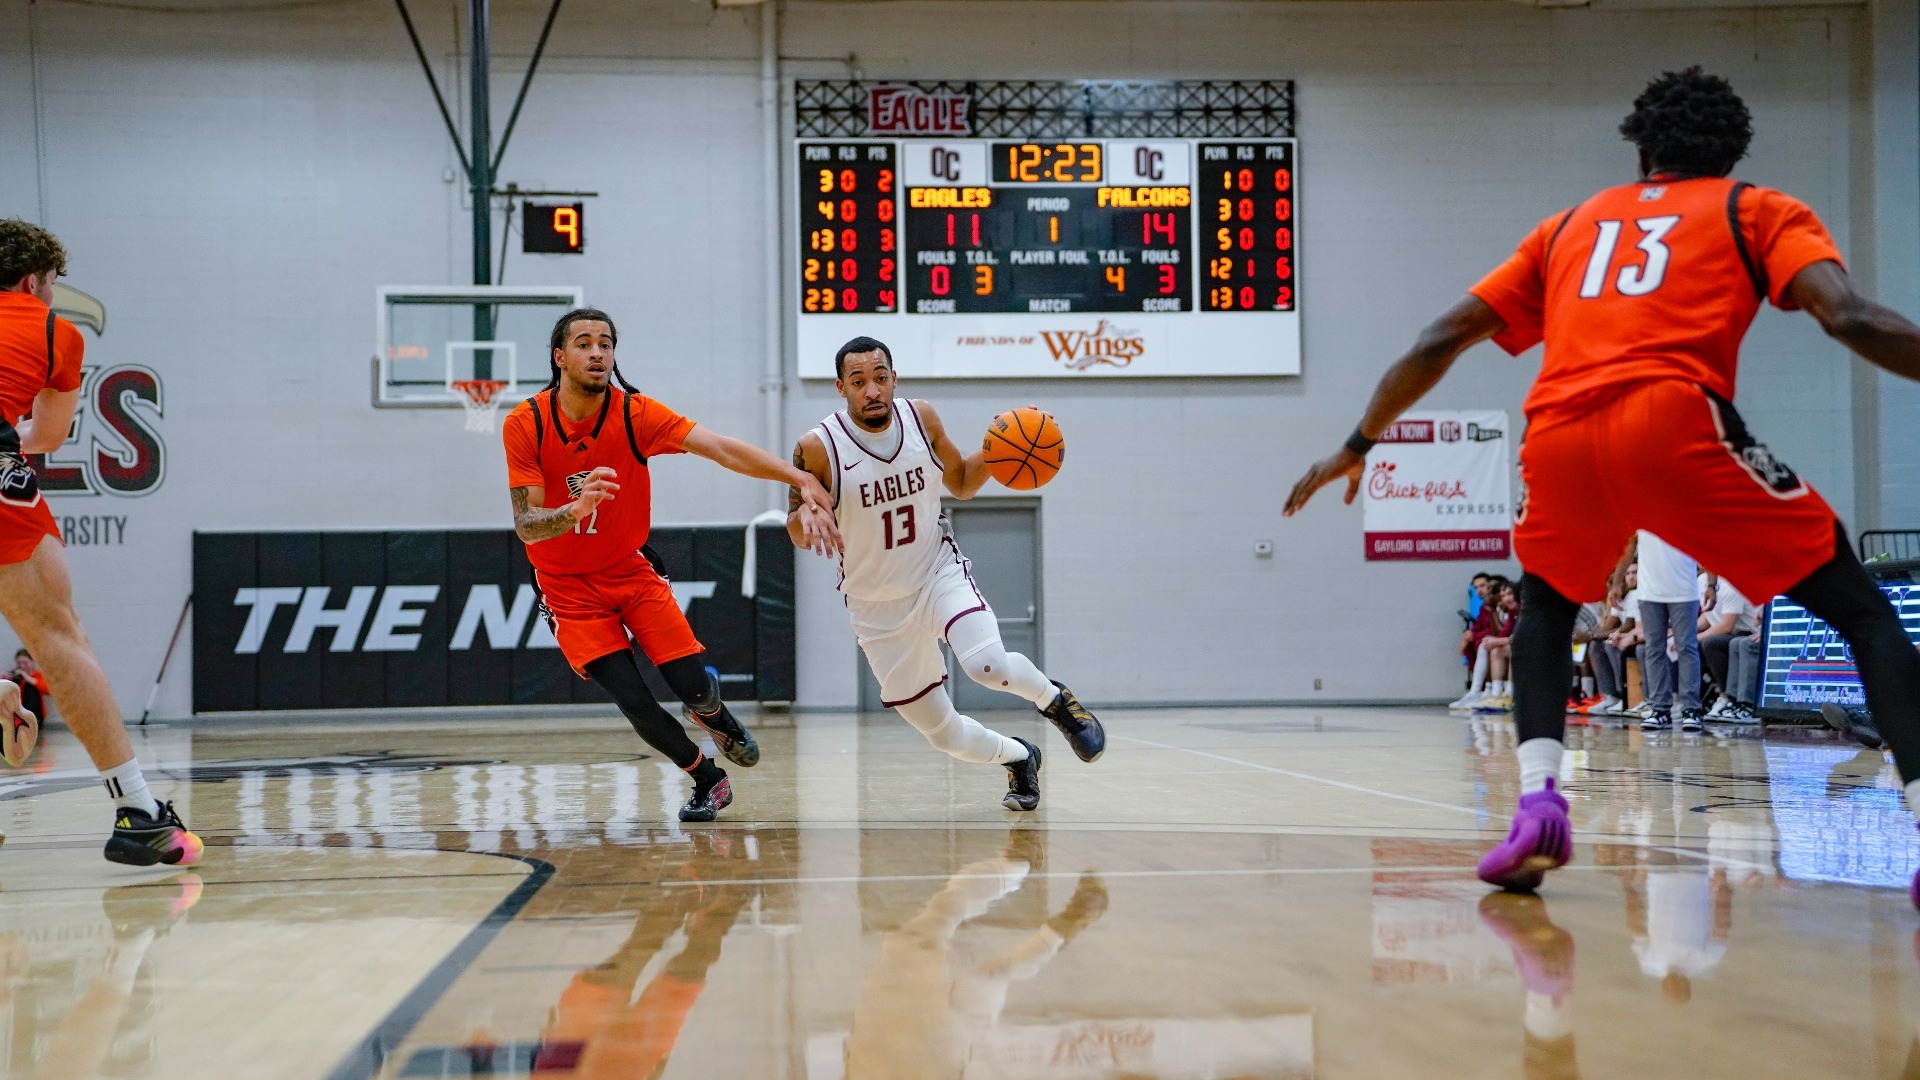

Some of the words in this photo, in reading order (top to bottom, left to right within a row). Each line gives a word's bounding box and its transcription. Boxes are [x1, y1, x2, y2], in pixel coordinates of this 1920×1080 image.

[870, 88, 970, 131] EAGLE
[805, 146, 830, 160] PLYR
[839, 146, 857, 160] FLS
[868, 146, 887, 160] PTS
[1010, 144, 1100, 182] 12:23
[1204, 146, 1229, 160] PLYR
[1237, 146, 1255, 160] FLS
[1265, 146, 1284, 160] PTS
[819, 169, 834, 193] 3
[840, 169, 856, 193] 0
[877, 169, 893, 193] 2
[1223, 170, 1232, 191] 1
[1238, 168, 1254, 192] 0
[1274, 168, 1290, 192] 0
[910, 187, 992, 208] EAGLES
[1027, 197, 1070, 212] PERIOD
[1097, 187, 1191, 208] FALCONS
[818, 201, 834, 221] 4
[840, 199, 857, 223] 0
[877, 199, 894, 223] 0
[1218, 198, 1232, 222] 3
[1238, 198, 1254, 222] 0
[1275, 198, 1291, 222] 0
[554, 207, 578, 247] 9
[946, 213, 981, 246] 11
[1050, 216, 1059, 243] 1
[1142, 212, 1176, 245] 14
[811, 229, 835, 252] 13
[841, 229, 857, 252] 0
[880, 229, 895, 252] 3
[1216, 228, 1233, 251] 5
[1239, 228, 1255, 251] 0
[1275, 228, 1291, 251] 0
[917, 250, 956, 265] FOULS
[965, 250, 999, 265] T.O.L.
[1010, 250, 1056, 265] PLAYER
[1058, 250, 1090, 265] FOUL
[1098, 250, 1131, 264] T.O.L.
[1141, 249, 1180, 264] FOULS
[1210, 257, 1233, 280] 12
[1246, 258, 1255, 277] 1
[1275, 256, 1291, 280] 6
[1579, 214, 1683, 299] 13
[804, 258, 835, 282] 21
[841, 258, 858, 282] 0
[879, 258, 895, 282] 2
[931, 265, 950, 296] 0
[975, 265, 993, 296] 3
[1105, 266, 1125, 293] 4
[1158, 264, 1176, 294] 3
[804, 288, 835, 311] 23
[841, 288, 858, 311] 0
[879, 289, 895, 310] 4
[917, 299, 956, 313] SCORE
[1029, 298, 1071, 312] MATCH
[1142, 298, 1181, 312] SCORE
[1210, 286, 1234, 309] 13
[1240, 286, 1255, 309] 0
[1276, 286, 1292, 309] 2
[956, 335, 1015, 346] FRIENDS
[1018, 335, 1036, 345] OF
[1040, 324, 1145, 369] Wings
[859, 466, 925, 508] EAGLES
[1436, 503, 1506, 515] EXPRESS
[56, 515, 128, 546] RSITY
[881, 504, 916, 550] 13
[1416, 538, 1467, 552] UNIVERSITY
[1468, 537, 1504, 551] CENTER
[233, 583, 441, 654] THE
